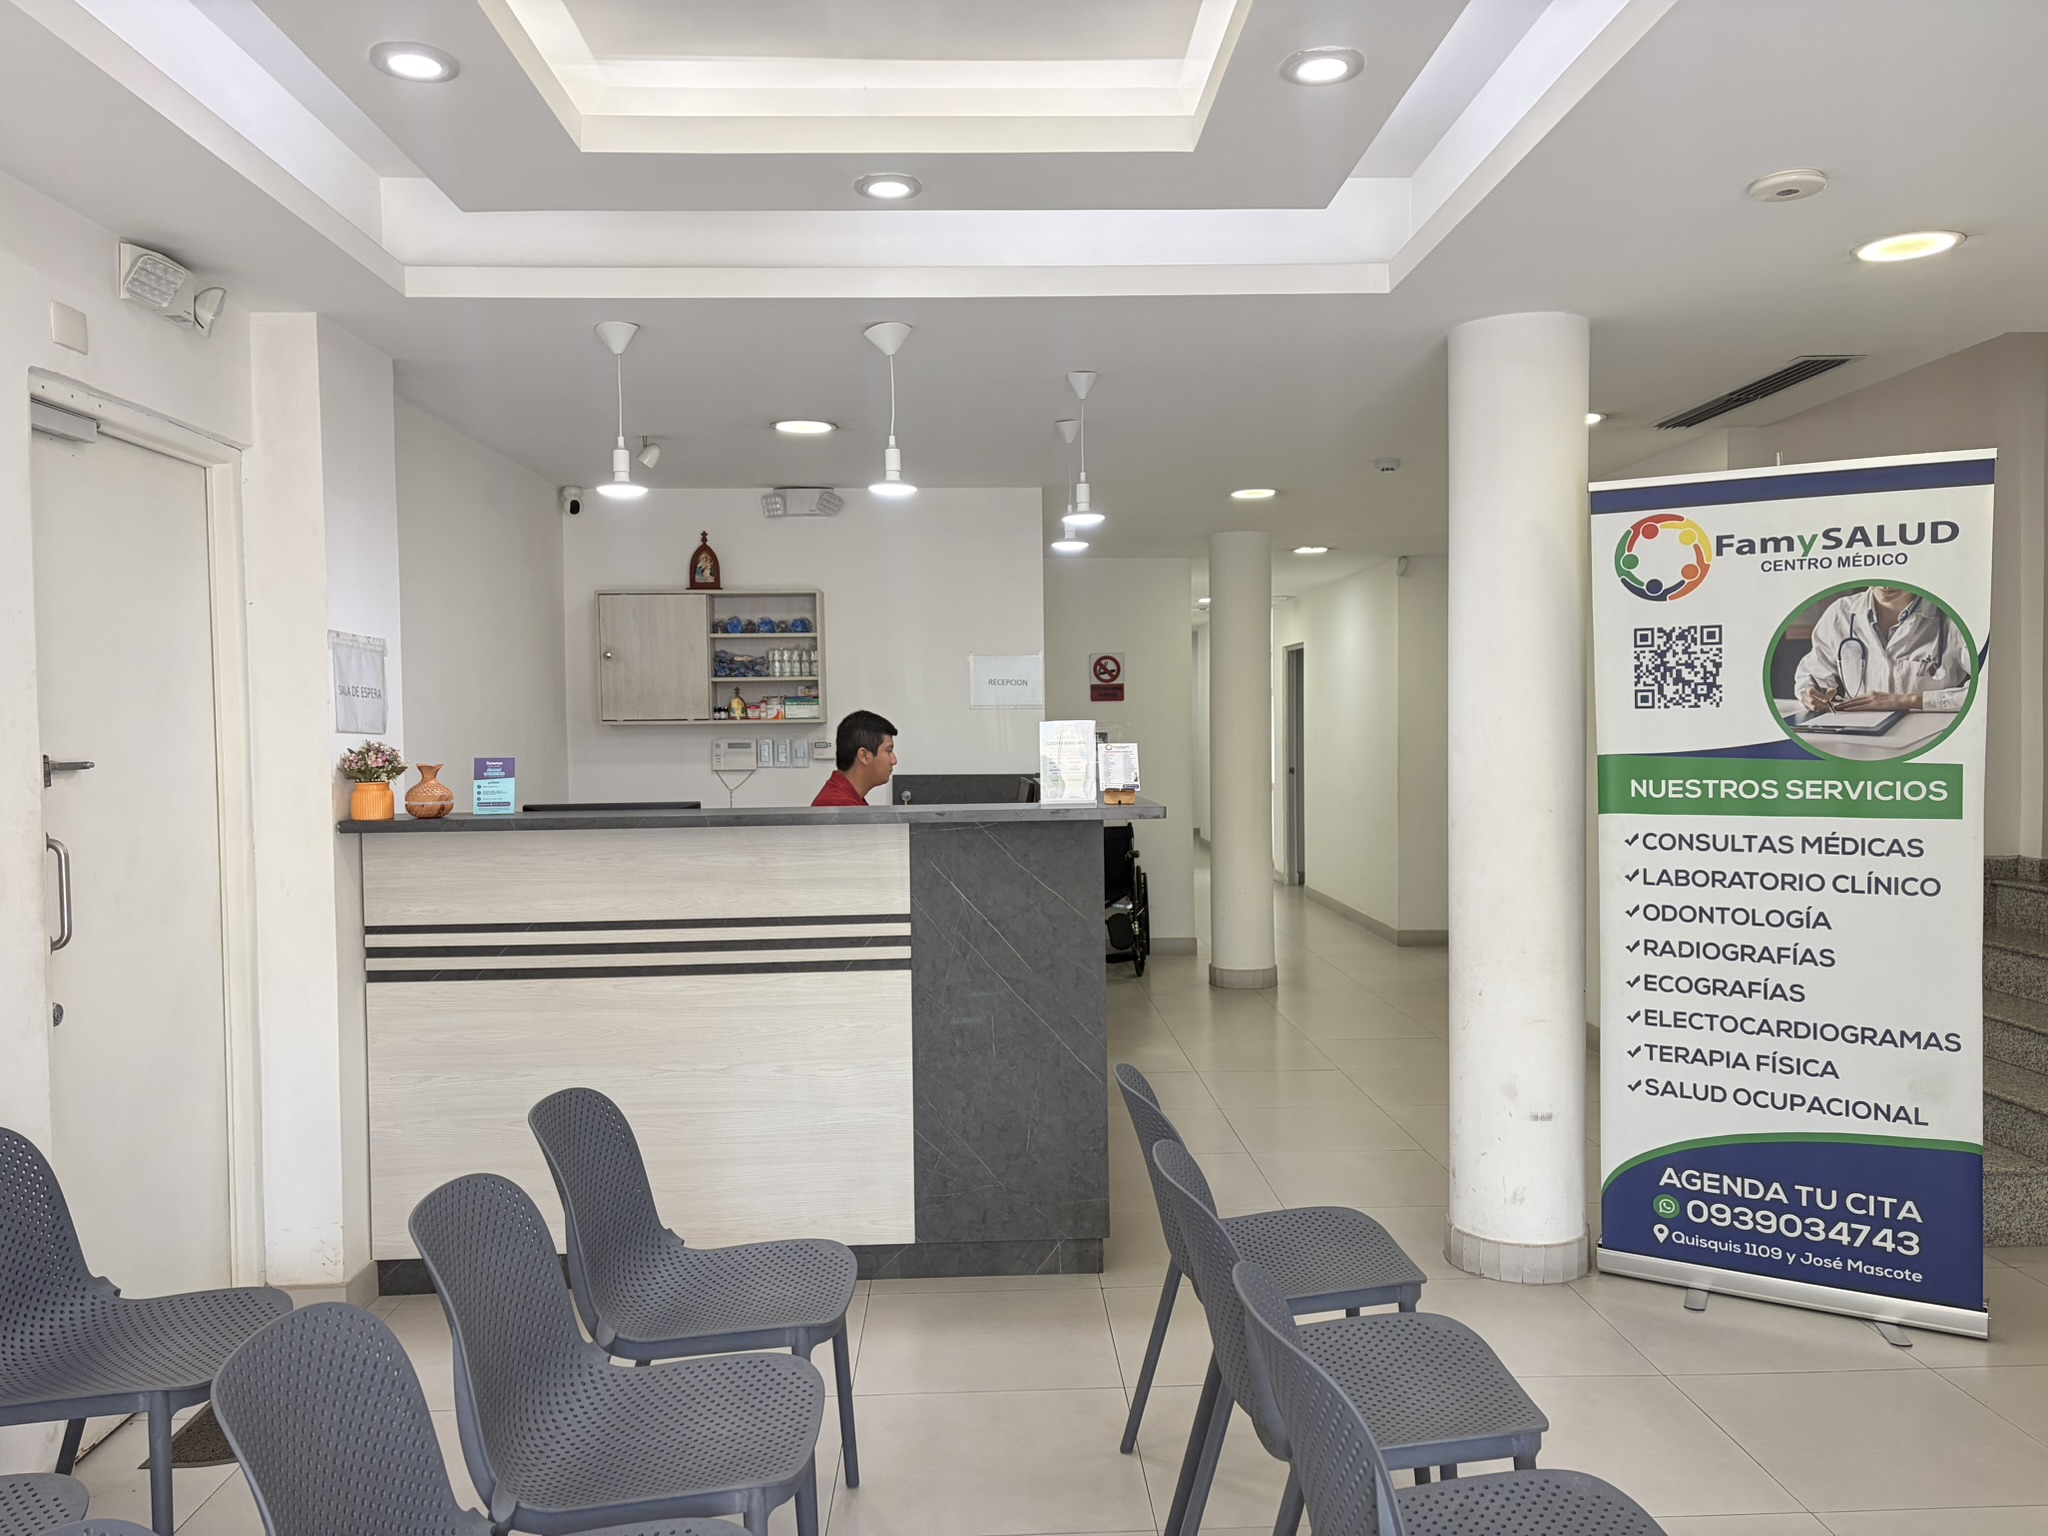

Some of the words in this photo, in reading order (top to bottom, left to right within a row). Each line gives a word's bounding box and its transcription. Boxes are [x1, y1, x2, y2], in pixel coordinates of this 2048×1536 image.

[1715, 520, 1961, 558] FamySALUD
[1760, 556, 1833, 573] CENTRO
[1837, 551, 1908, 569] MÉDICO
[338, 685, 351, 696] SALA
[351, 685, 360, 697] DE
[360, 686, 382, 699] ESPERA
[988, 678, 1028, 686] RECEPCION
[1630, 778, 1780, 800] NUESTROS
[1785, 779, 1948, 802] SERVICIOS
[1642, 832, 1795, 855] CONSULTAS
[1801, 831, 1925, 858] MÉDICAS
[1642, 867, 1826, 893] LABORATORIO
[1831, 870, 1942, 897] CLÍNICO
[1642, 903, 1833, 931] ODONTOLOGÍA
[1643, 938, 1836, 968] RADIOGRAFÍAS
[1644, 973, 1806, 1003] ECOGRAFÍAS
[1644, 1008, 1962, 1053] ELECTOCARDIOGRAMAS
[1643, 1043, 1751, 1071] TERAPIA
[1756, 1050, 1840, 1080] FÍSICA
[1645, 1078, 1728, 1103] SALUD
[1732, 1087, 1929, 1127] OCUPACIONAL
[1658, 1166, 1789, 1204] AGENDA
[1794, 1184, 1837, 1210] TU
[1845, 1192, 1923, 1224] CITA
[1686, 1199, 1921, 1257] 0939034743
[1671, 1231, 1742, 1254] Quisquis
[1744, 1242, 1783, 1260] 1109
[1785, 1252, 1797, 1265] y
[1800, 1252, 1843, 1270] José
[1847, 1258, 1923, 1284] Mascote
